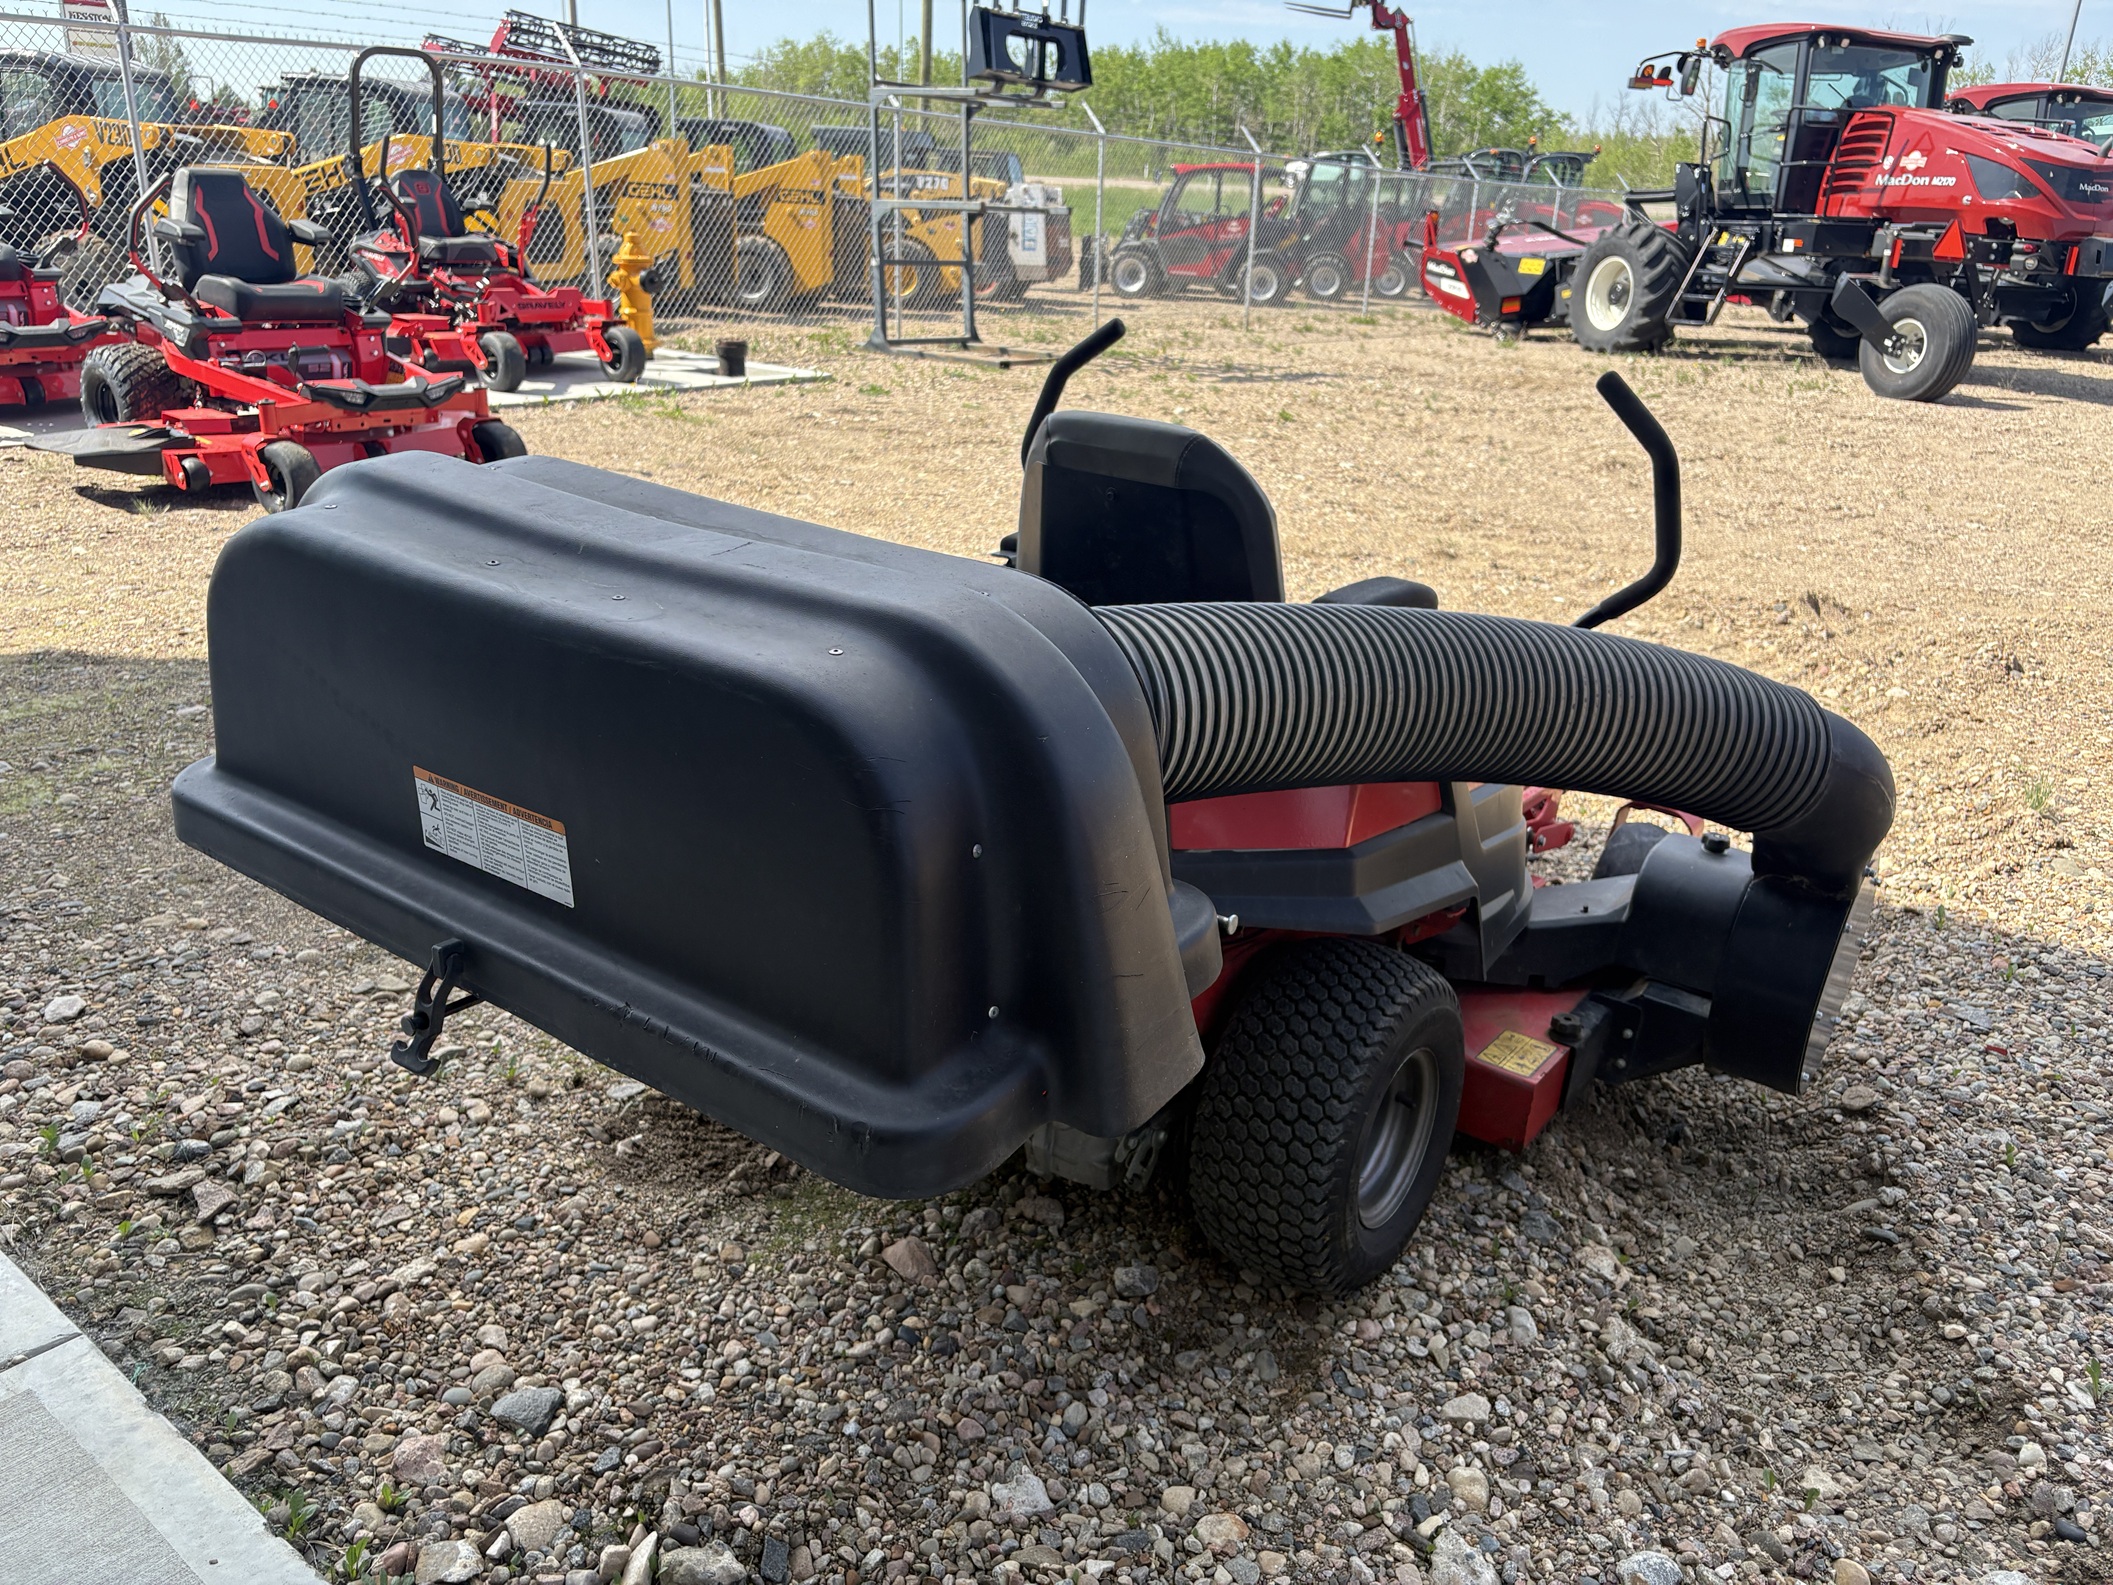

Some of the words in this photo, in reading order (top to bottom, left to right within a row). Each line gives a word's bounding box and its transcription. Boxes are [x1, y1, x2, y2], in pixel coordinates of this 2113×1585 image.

[1875, 173, 1930, 187] MacDon
[2079, 182, 2110, 193] MacDon
[627, 183, 674, 199] GEHL
[434, 776, 460, 793] WARNING
[464, 788, 508, 811] AVERTISSEMENT
[512, 807, 553, 828] ADVERTENCIA
